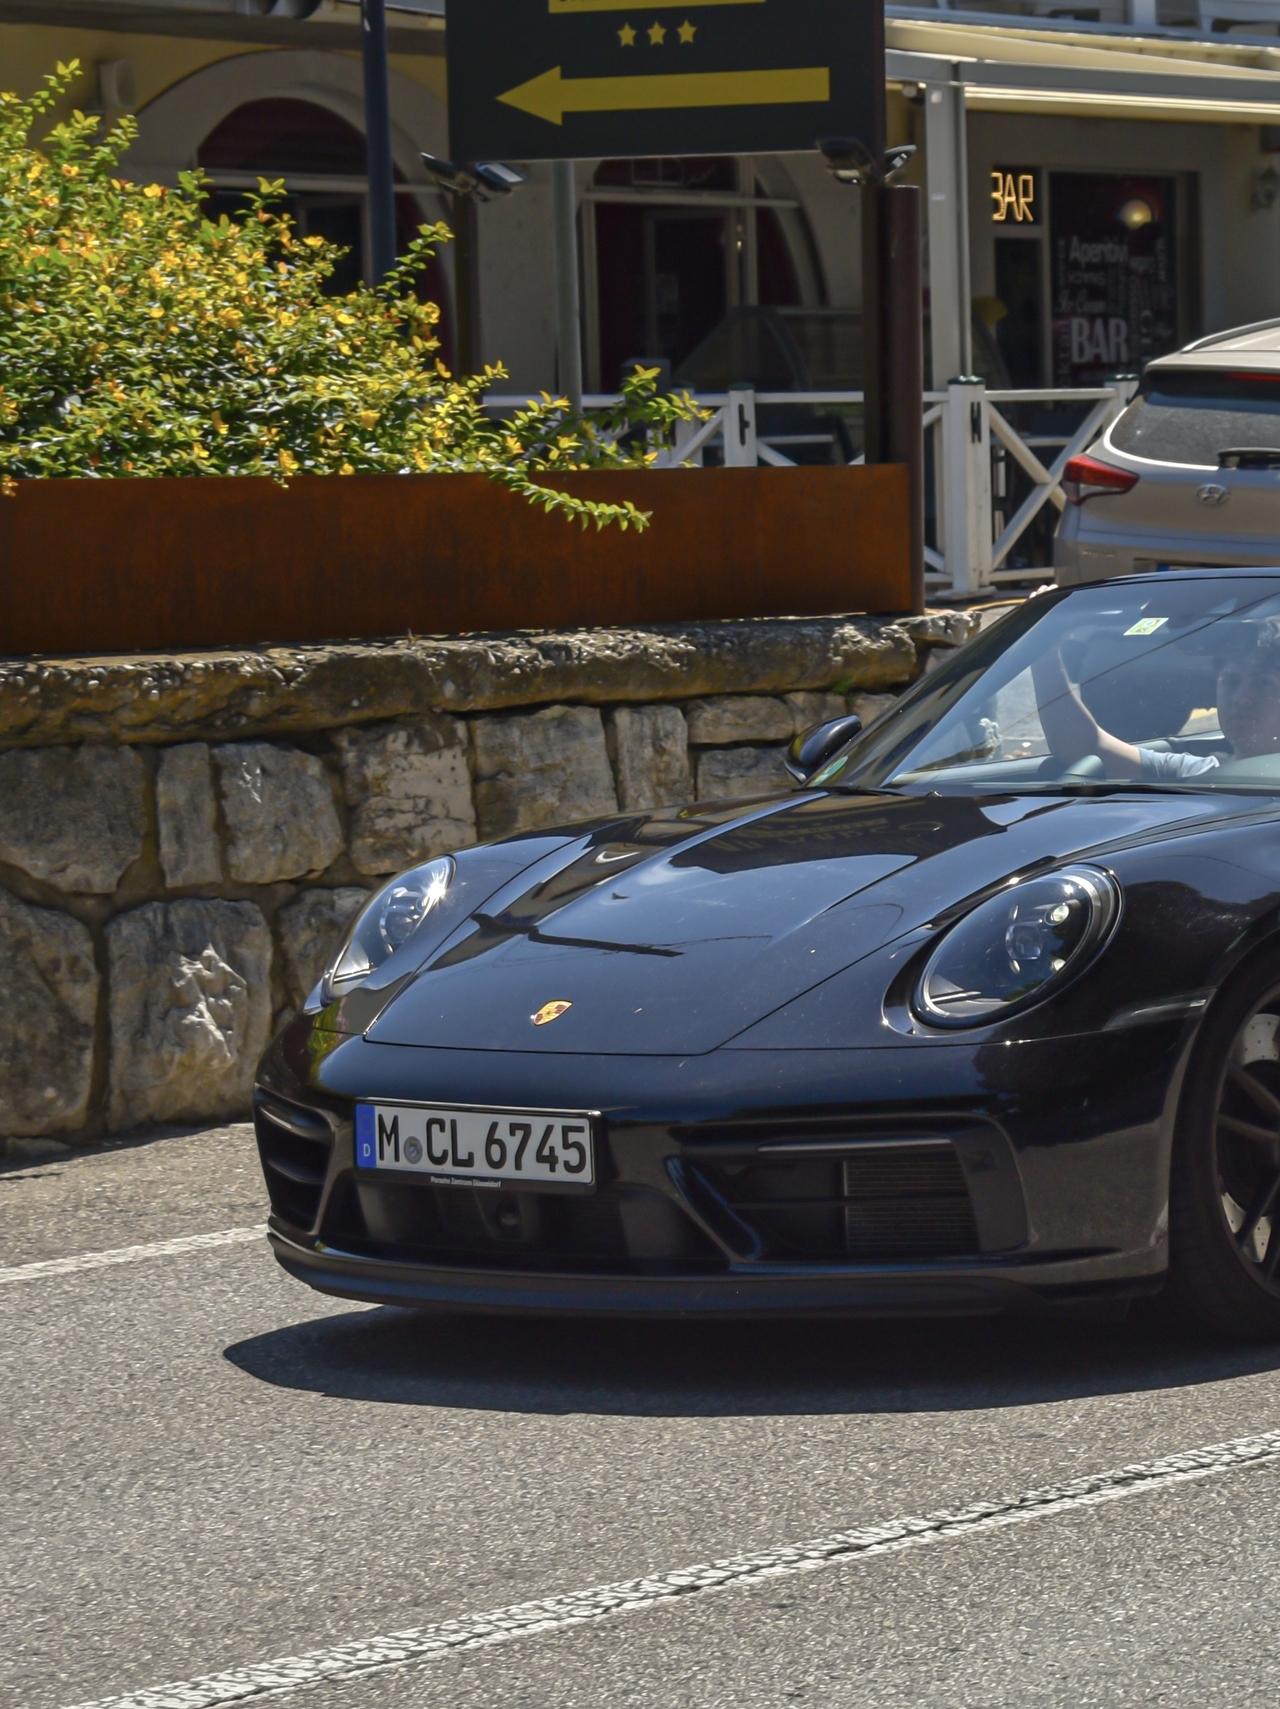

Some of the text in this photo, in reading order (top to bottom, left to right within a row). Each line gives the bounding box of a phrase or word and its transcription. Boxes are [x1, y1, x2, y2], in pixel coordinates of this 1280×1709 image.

[991, 172, 1034, 222] BAR
[1071, 317, 1129, 364] BAR
[363, 1143, 371, 1157] D
[378, 1114, 587, 1174] M CL 6745
